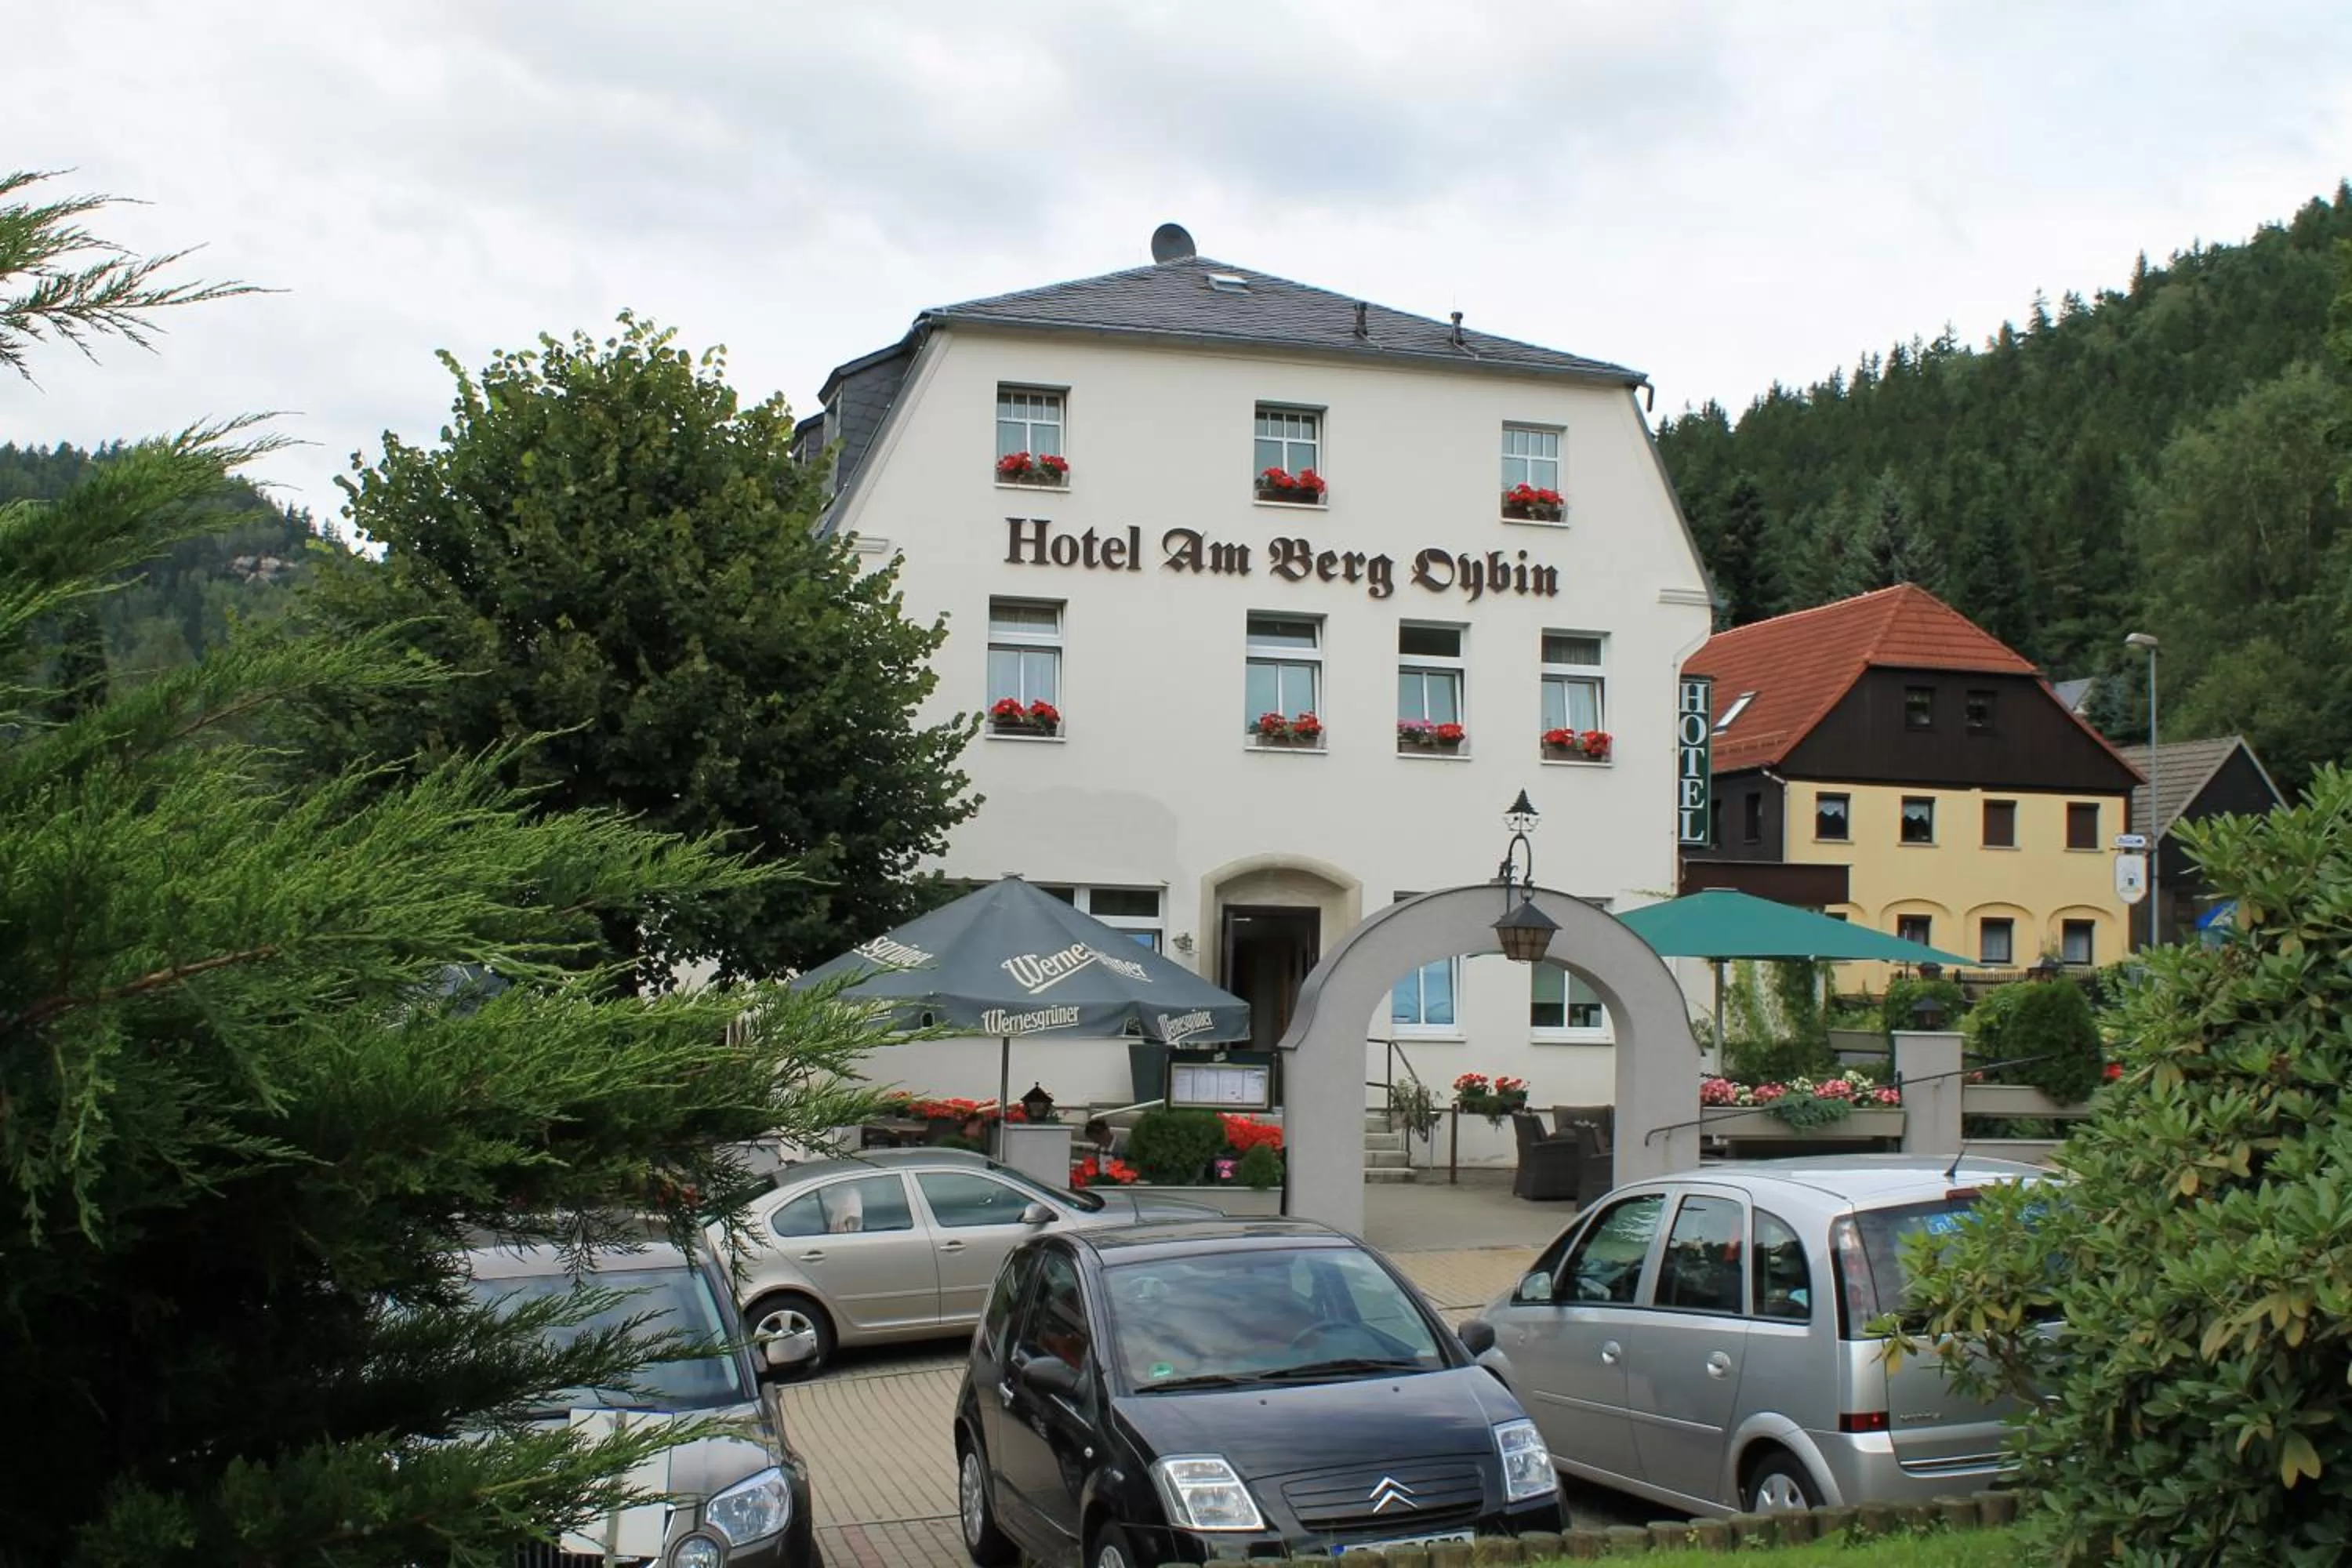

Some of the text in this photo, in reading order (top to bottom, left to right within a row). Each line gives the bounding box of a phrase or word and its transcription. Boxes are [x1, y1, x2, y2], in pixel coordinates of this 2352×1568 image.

[1005, 517, 1558, 602] Hotel Am Berg Oybin
[1679, 681, 1708, 841] HOTEL
[982, 1004, 1080, 1034] Wernesgrüner
